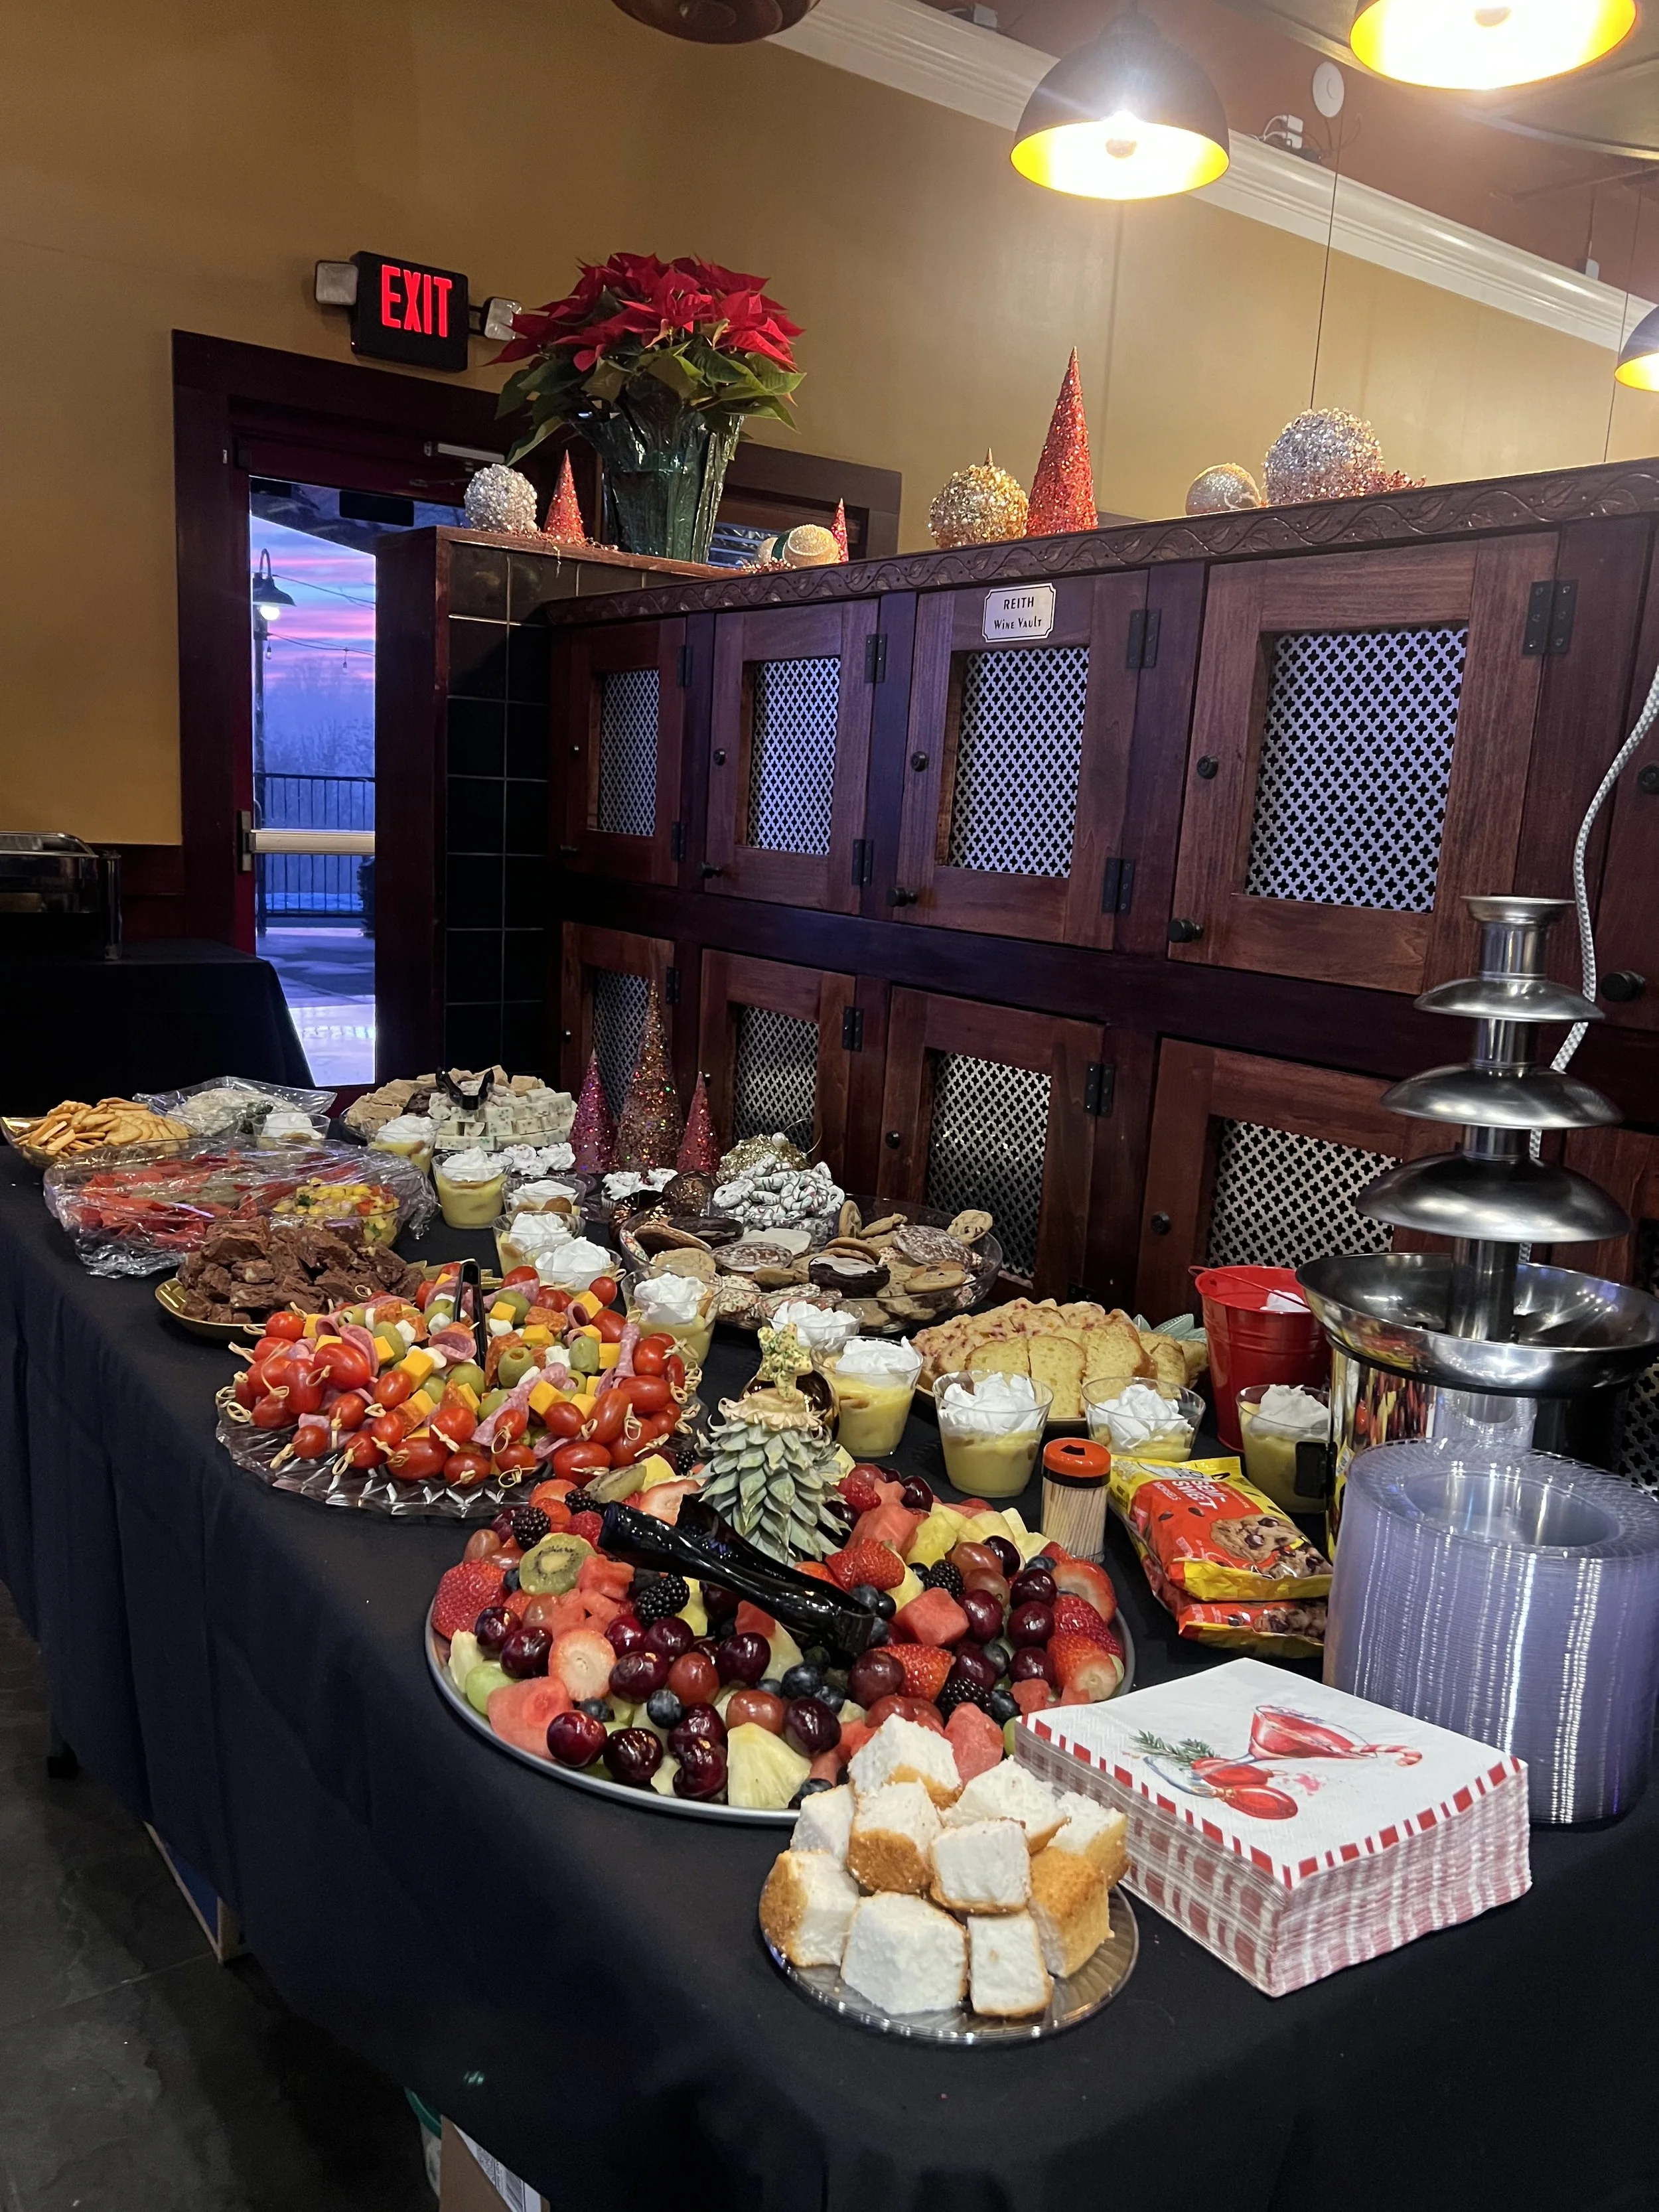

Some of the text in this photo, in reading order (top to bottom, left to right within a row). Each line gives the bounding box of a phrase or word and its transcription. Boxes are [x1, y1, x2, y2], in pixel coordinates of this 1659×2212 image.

[382, 264, 453, 337] EXIT
[1003, 597, 1035, 610] REITH
[1172, 1481, 1218, 1510] SWEET
